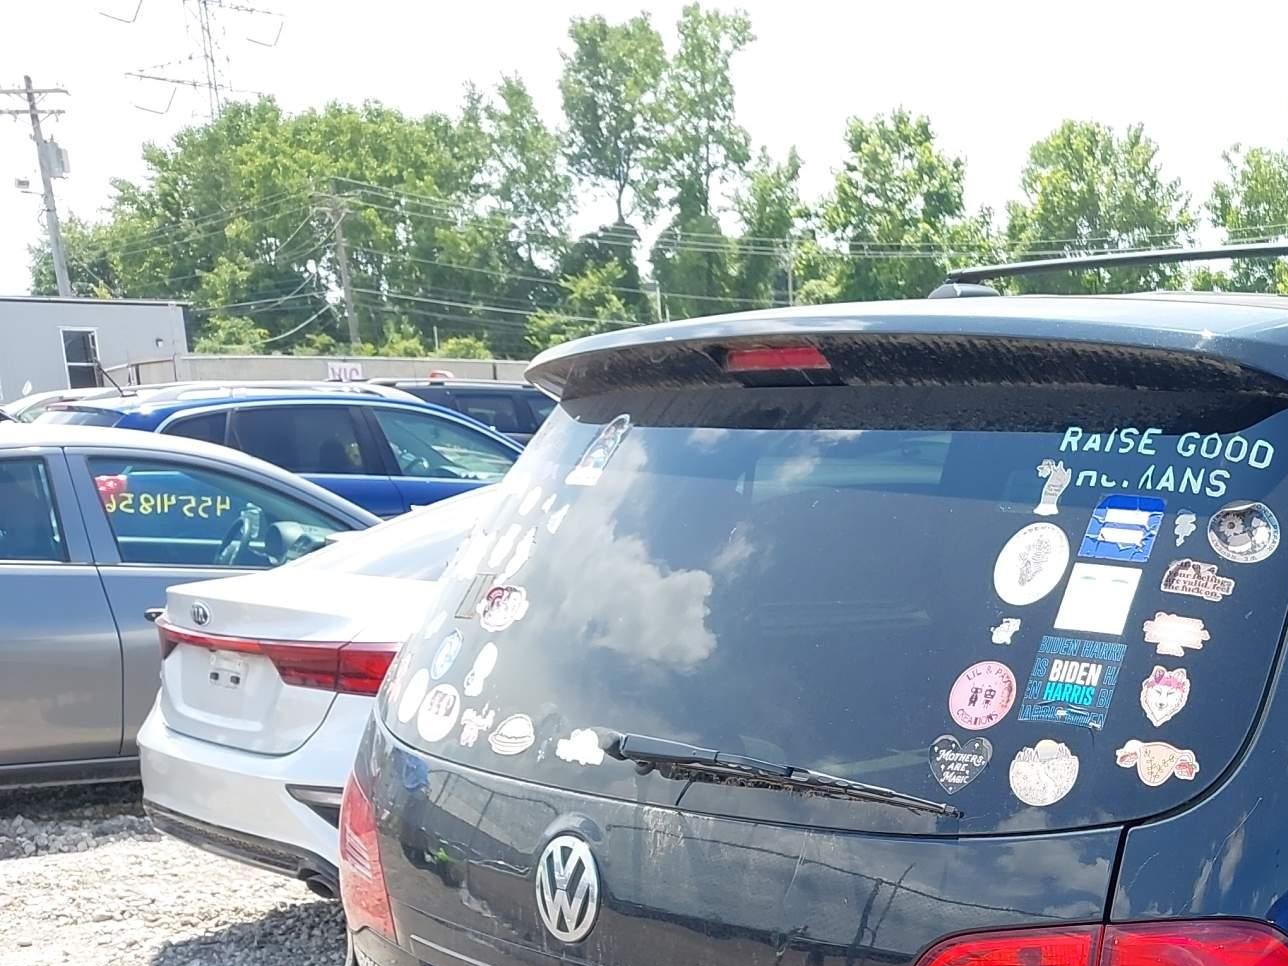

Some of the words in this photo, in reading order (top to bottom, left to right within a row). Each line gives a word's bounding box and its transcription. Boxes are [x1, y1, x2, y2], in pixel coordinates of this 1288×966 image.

[1059, 426, 1162, 456] RAISE
[1177, 432, 1274, 469] GOOD
[1048, 659, 1103, 686] BIDEN
[1043, 682, 1096, 706] HARRIS
[936, 749, 983, 767] MOTHERS
[947, 763, 968, 772] ARE
[940, 771, 970, 784] MAGIC
